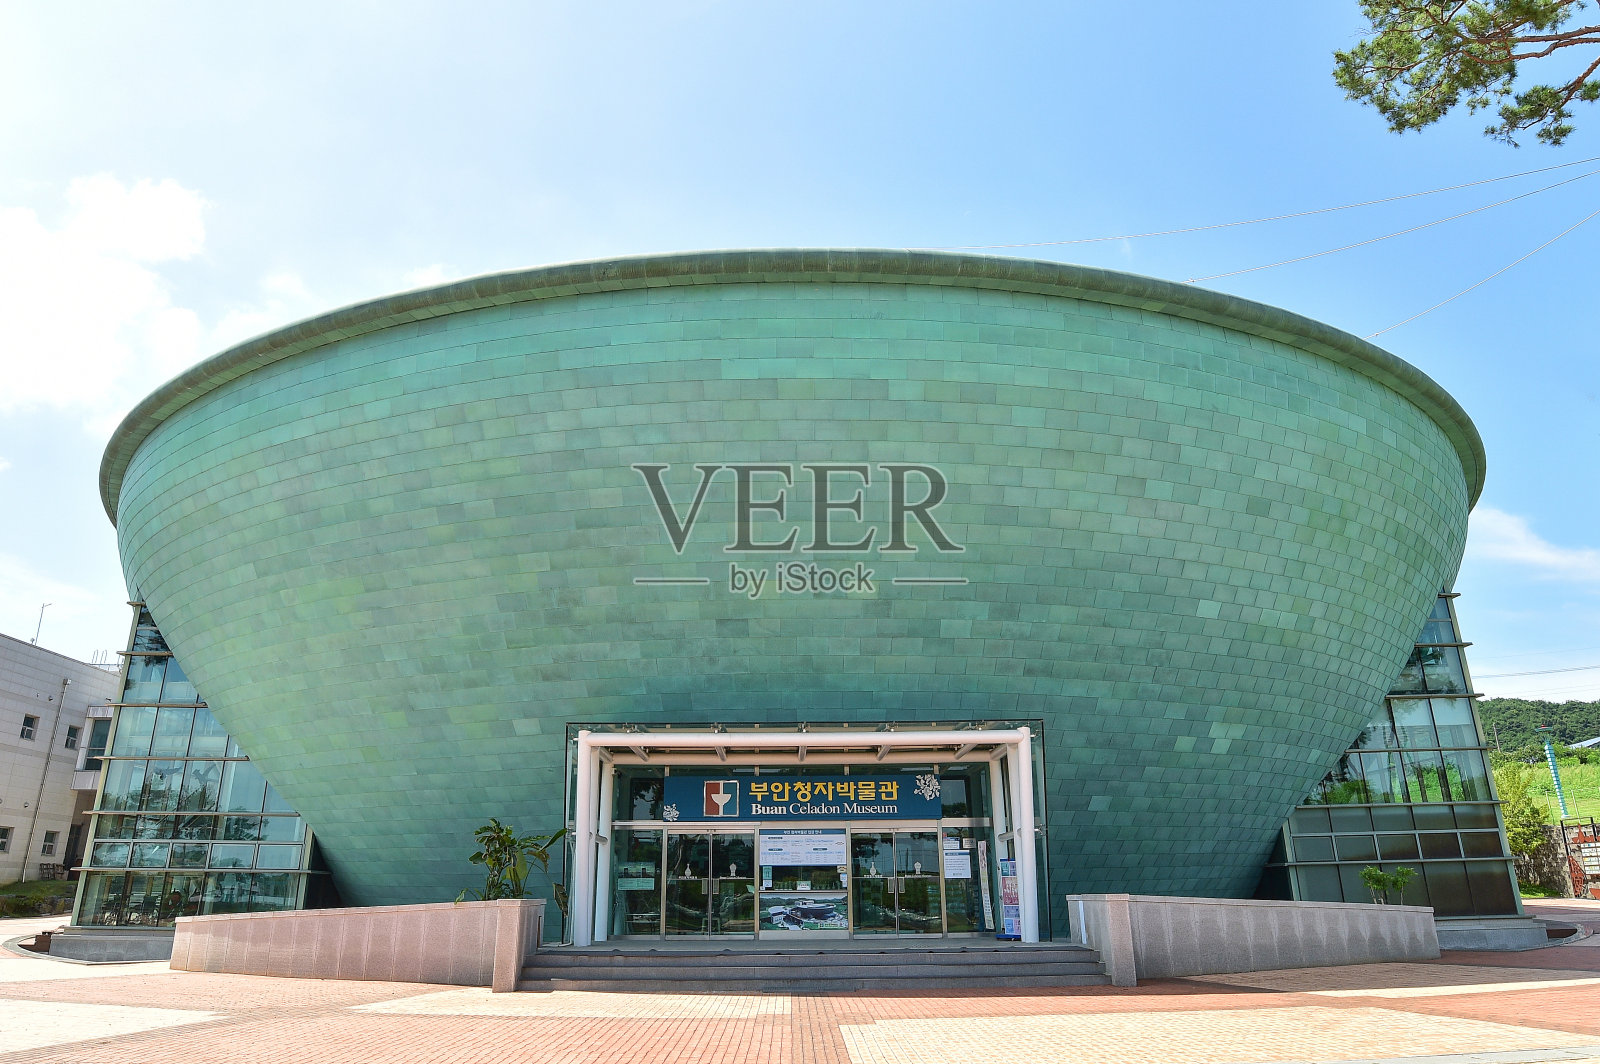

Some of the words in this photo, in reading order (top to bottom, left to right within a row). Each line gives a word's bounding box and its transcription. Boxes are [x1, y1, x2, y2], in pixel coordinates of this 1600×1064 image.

[749, 781, 899, 802] 부안청자박물관
[751, 803, 787, 815] Buan
[789, 802, 840, 815] Celadon
[843, 802, 898, 814] Museum
